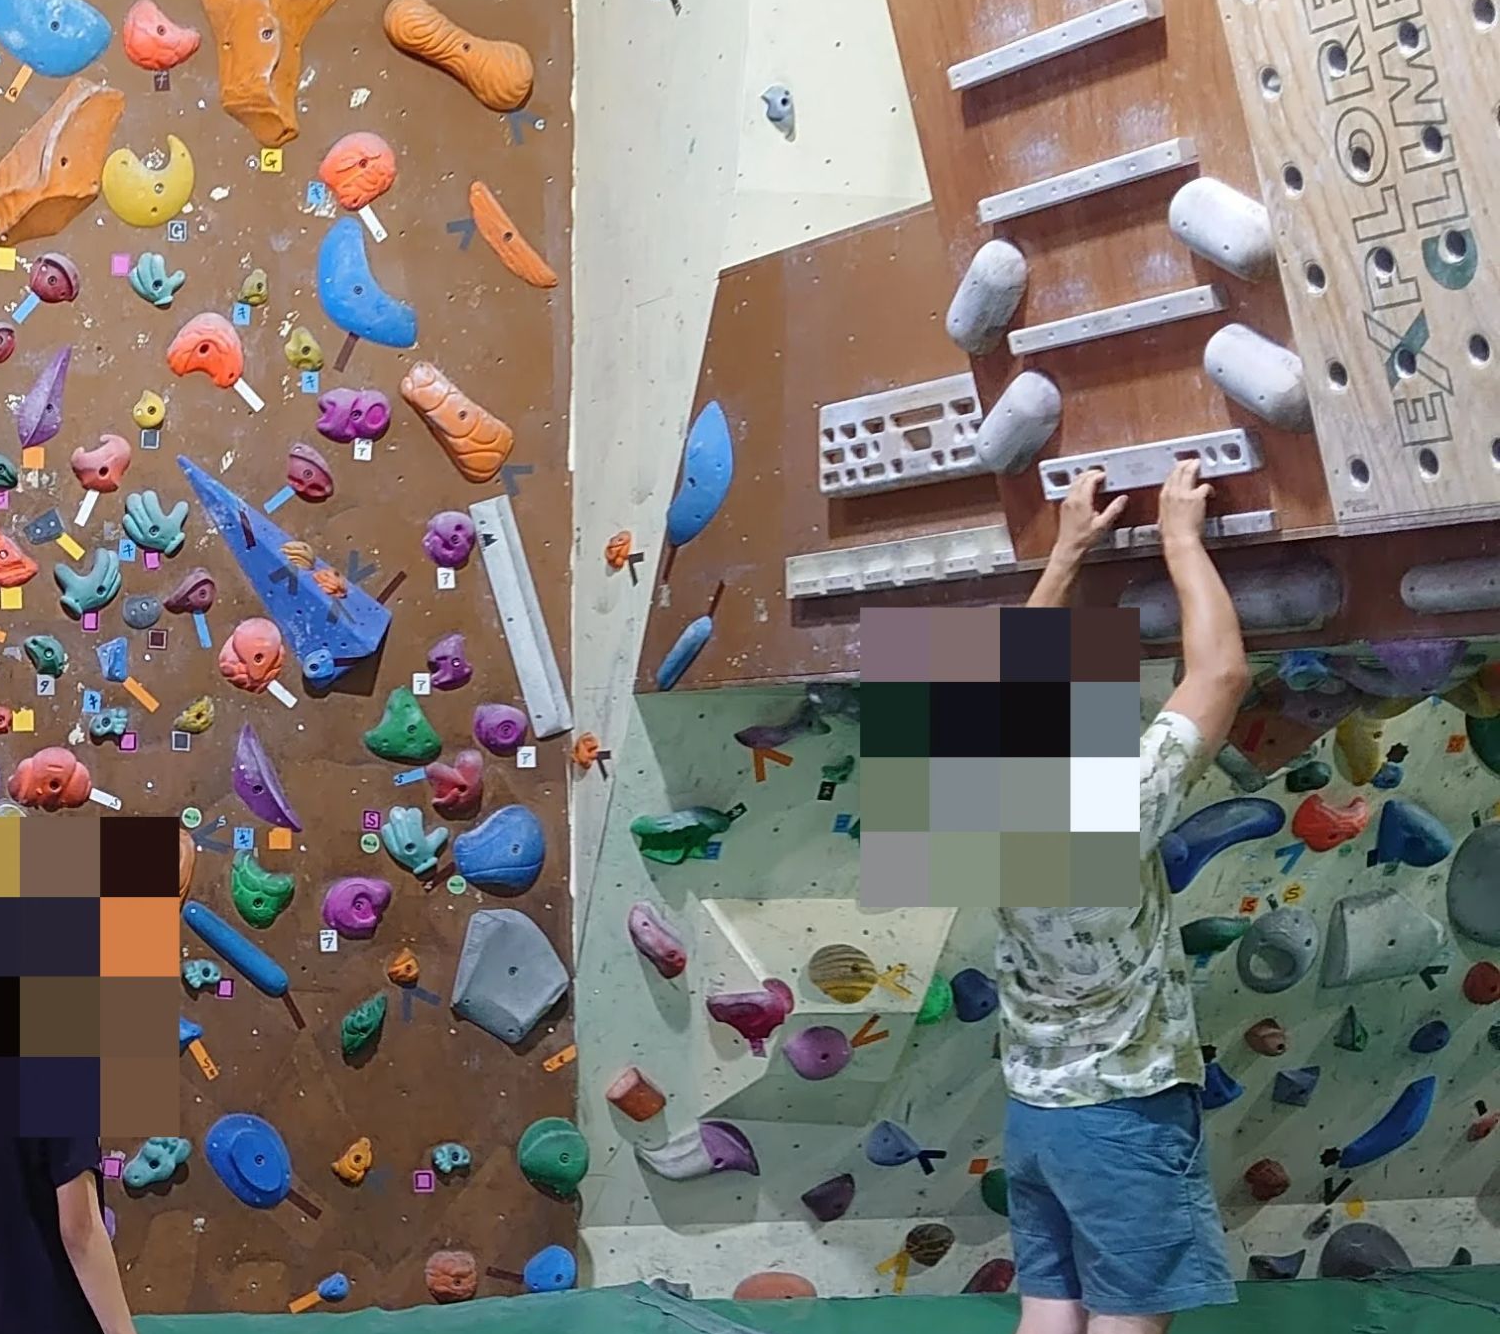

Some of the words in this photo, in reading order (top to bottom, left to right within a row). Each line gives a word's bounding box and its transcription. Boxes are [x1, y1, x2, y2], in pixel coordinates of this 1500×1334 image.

[263, 152, 277, 169] G
[171, 223, 183, 239] G
[216, 815, 227, 827] S
[367, 813, 377, 827] S
